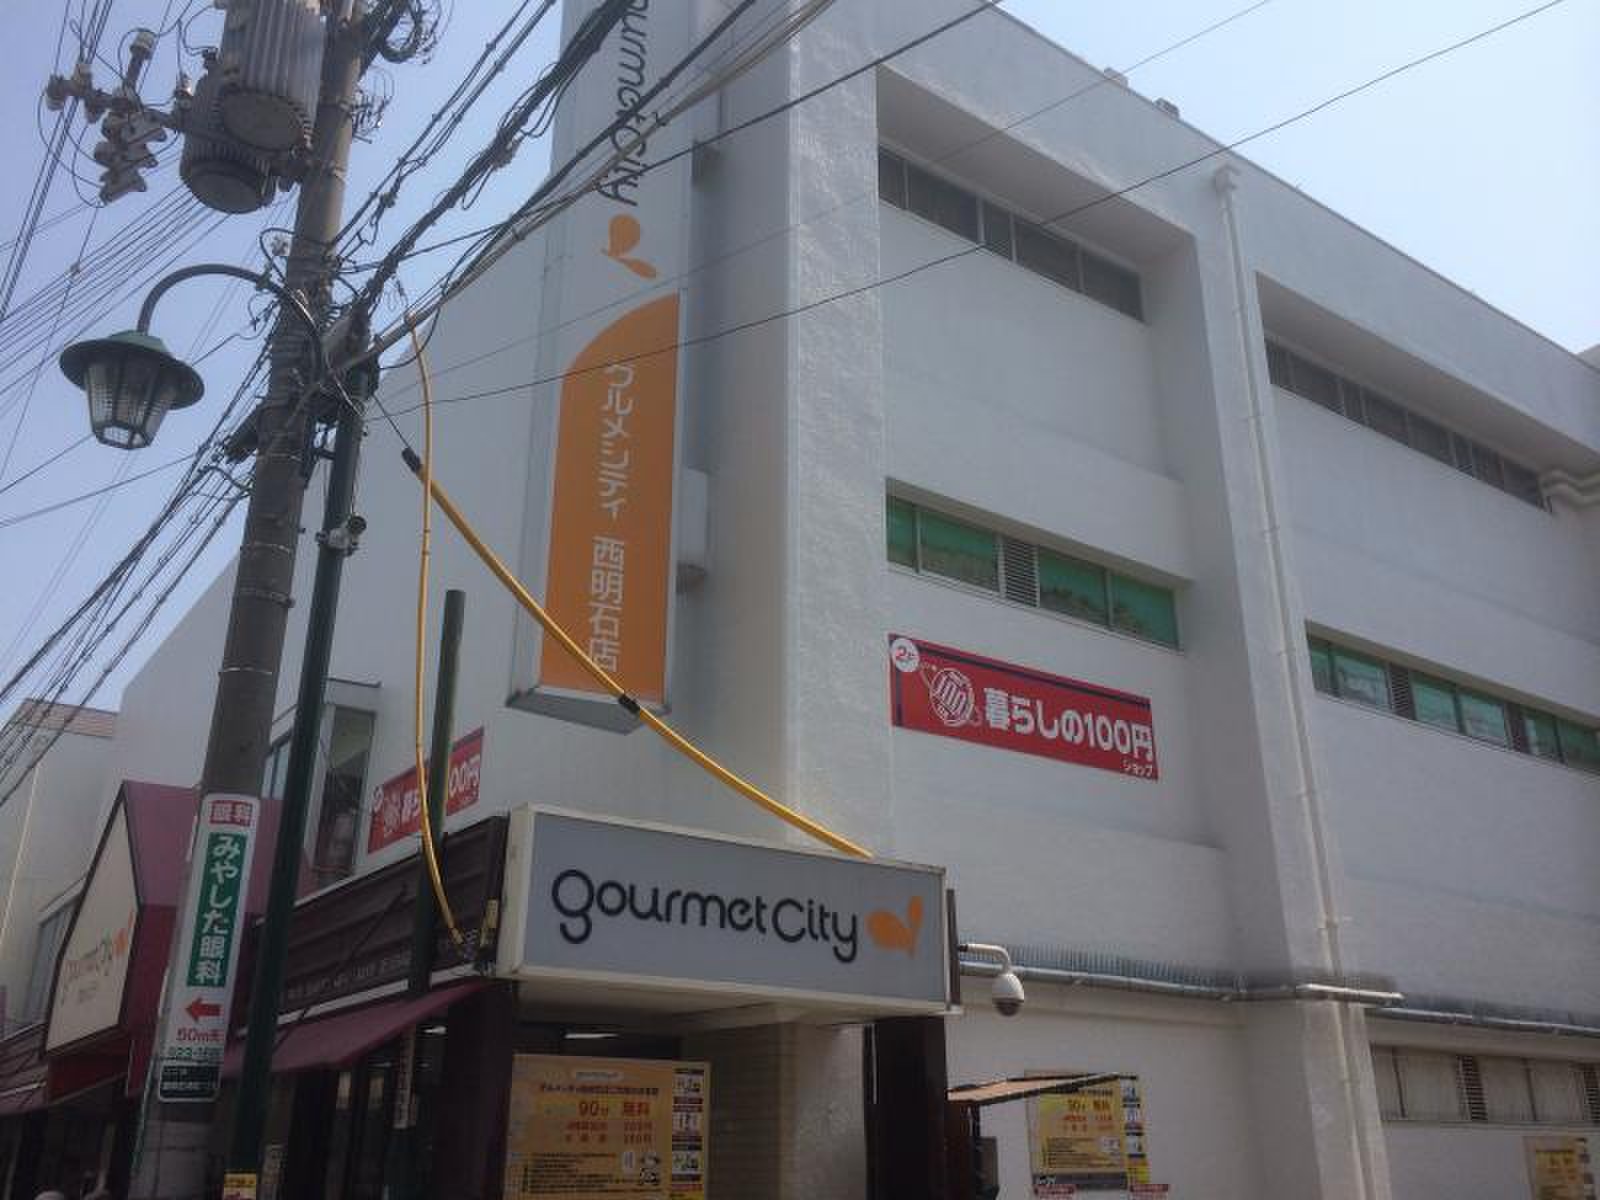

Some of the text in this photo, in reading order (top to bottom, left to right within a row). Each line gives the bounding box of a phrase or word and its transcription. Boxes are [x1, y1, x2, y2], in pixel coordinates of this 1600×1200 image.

[984, 686, 1153, 761] 暮らしの100円
[196, 835, 241, 985] みやした眼科
